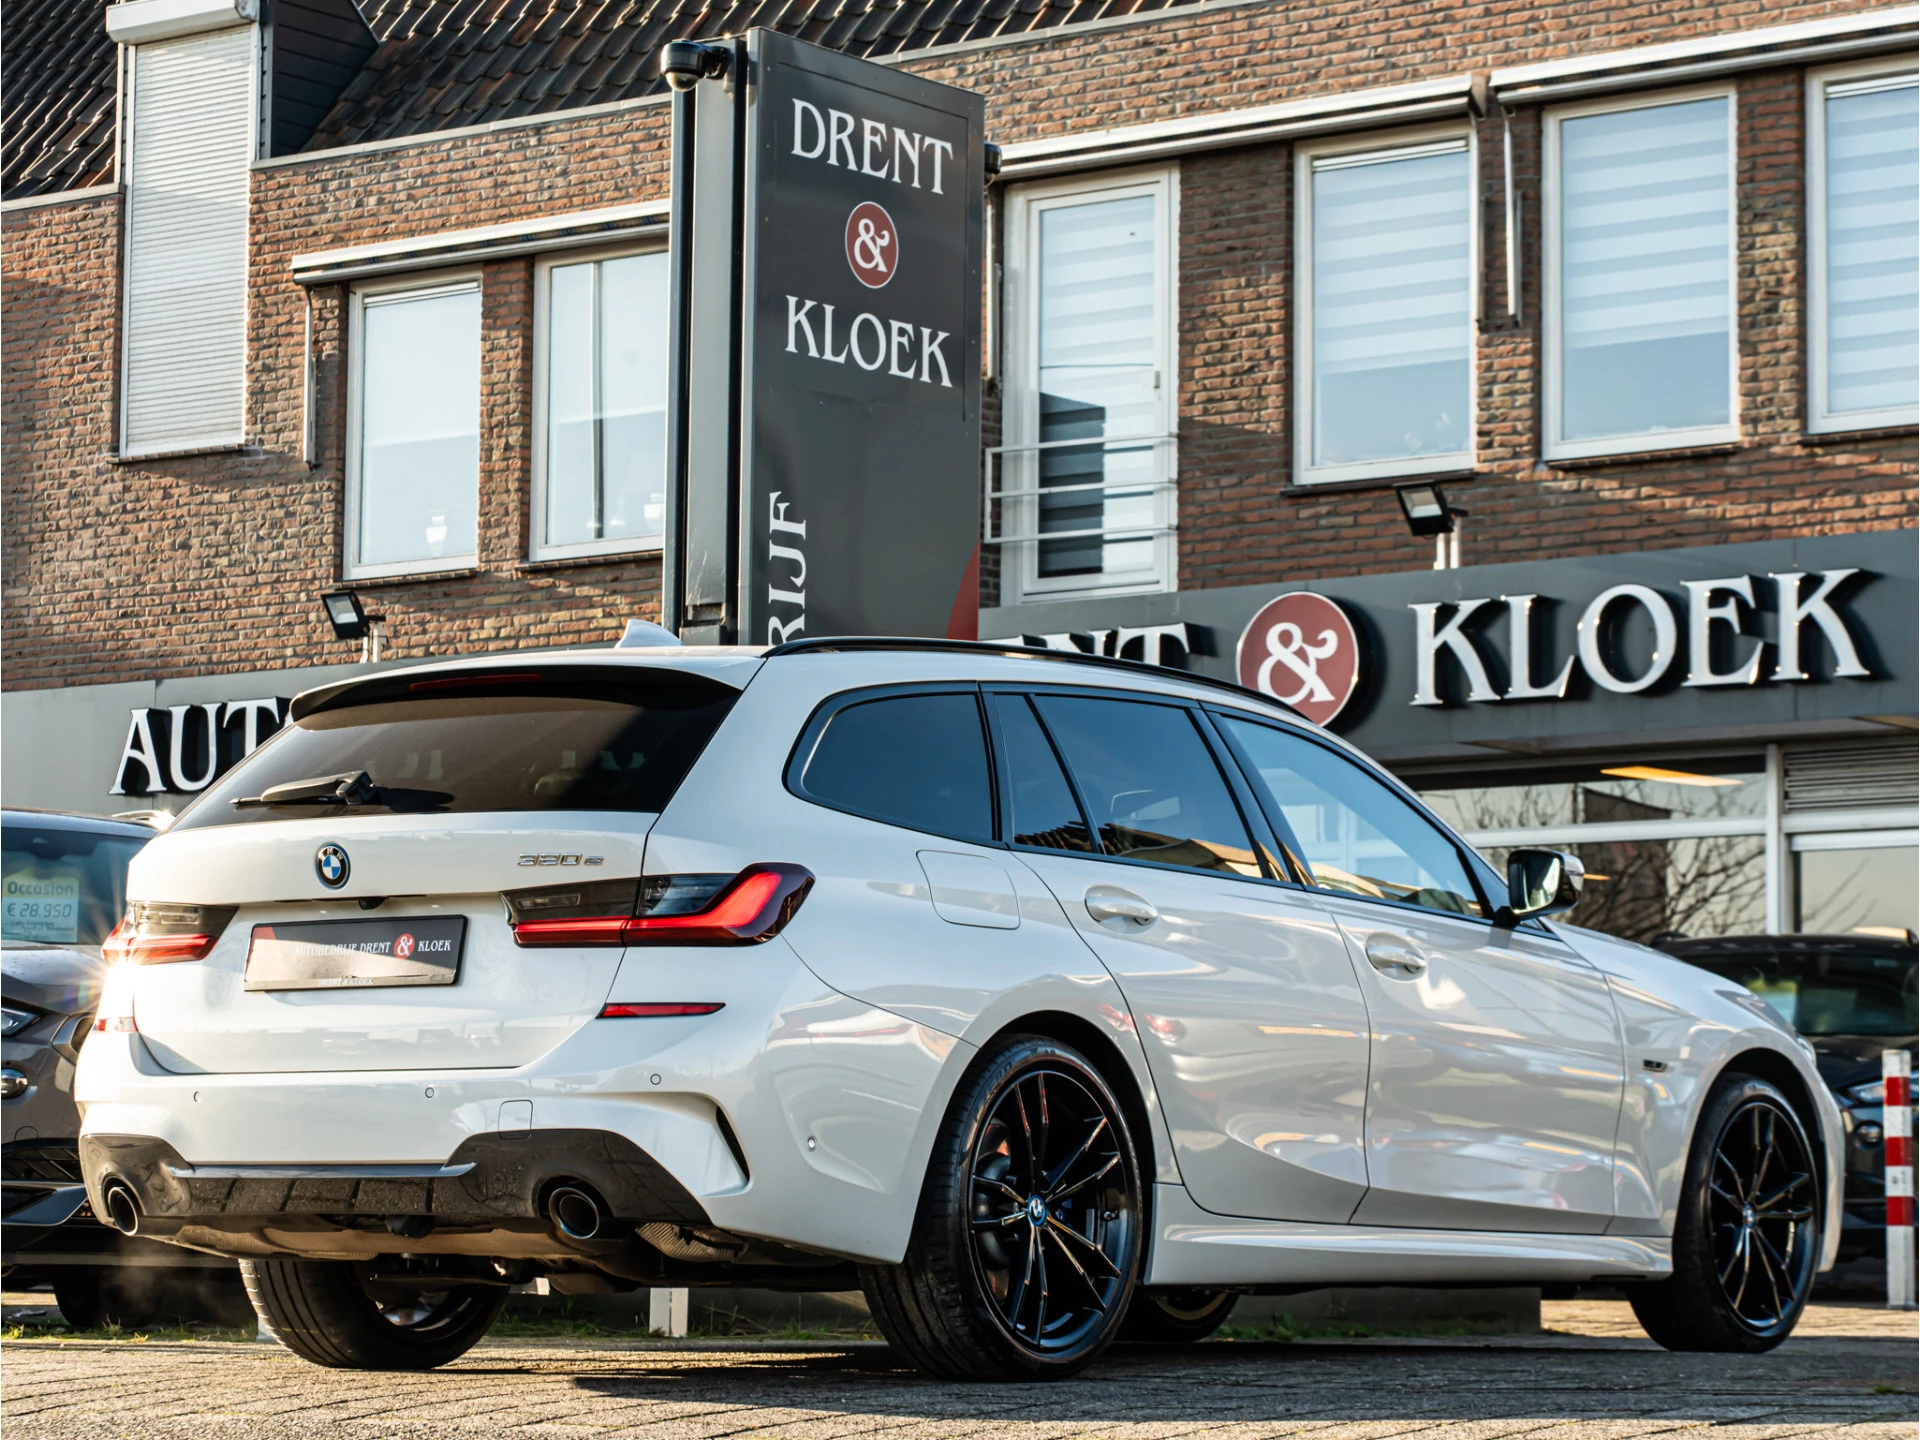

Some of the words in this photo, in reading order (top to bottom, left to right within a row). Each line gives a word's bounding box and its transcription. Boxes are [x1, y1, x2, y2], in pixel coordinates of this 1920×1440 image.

[791, 98, 953, 195] DRENT
[853, 218, 890, 273] &
[785, 295, 953, 388] KLOEK
[1257, 622, 1337, 704] &
[1407, 567, 1871, 706] KLOEK
[7, 881, 74, 895] Occasion
[20, 902, 72, 918] 28.950
[294, 943, 357, 956] AUTOBEDRIJF
[359, 941, 391, 954] DRENT
[397, 936, 412, 956] &
[418, 940, 451, 951] KLOEK
